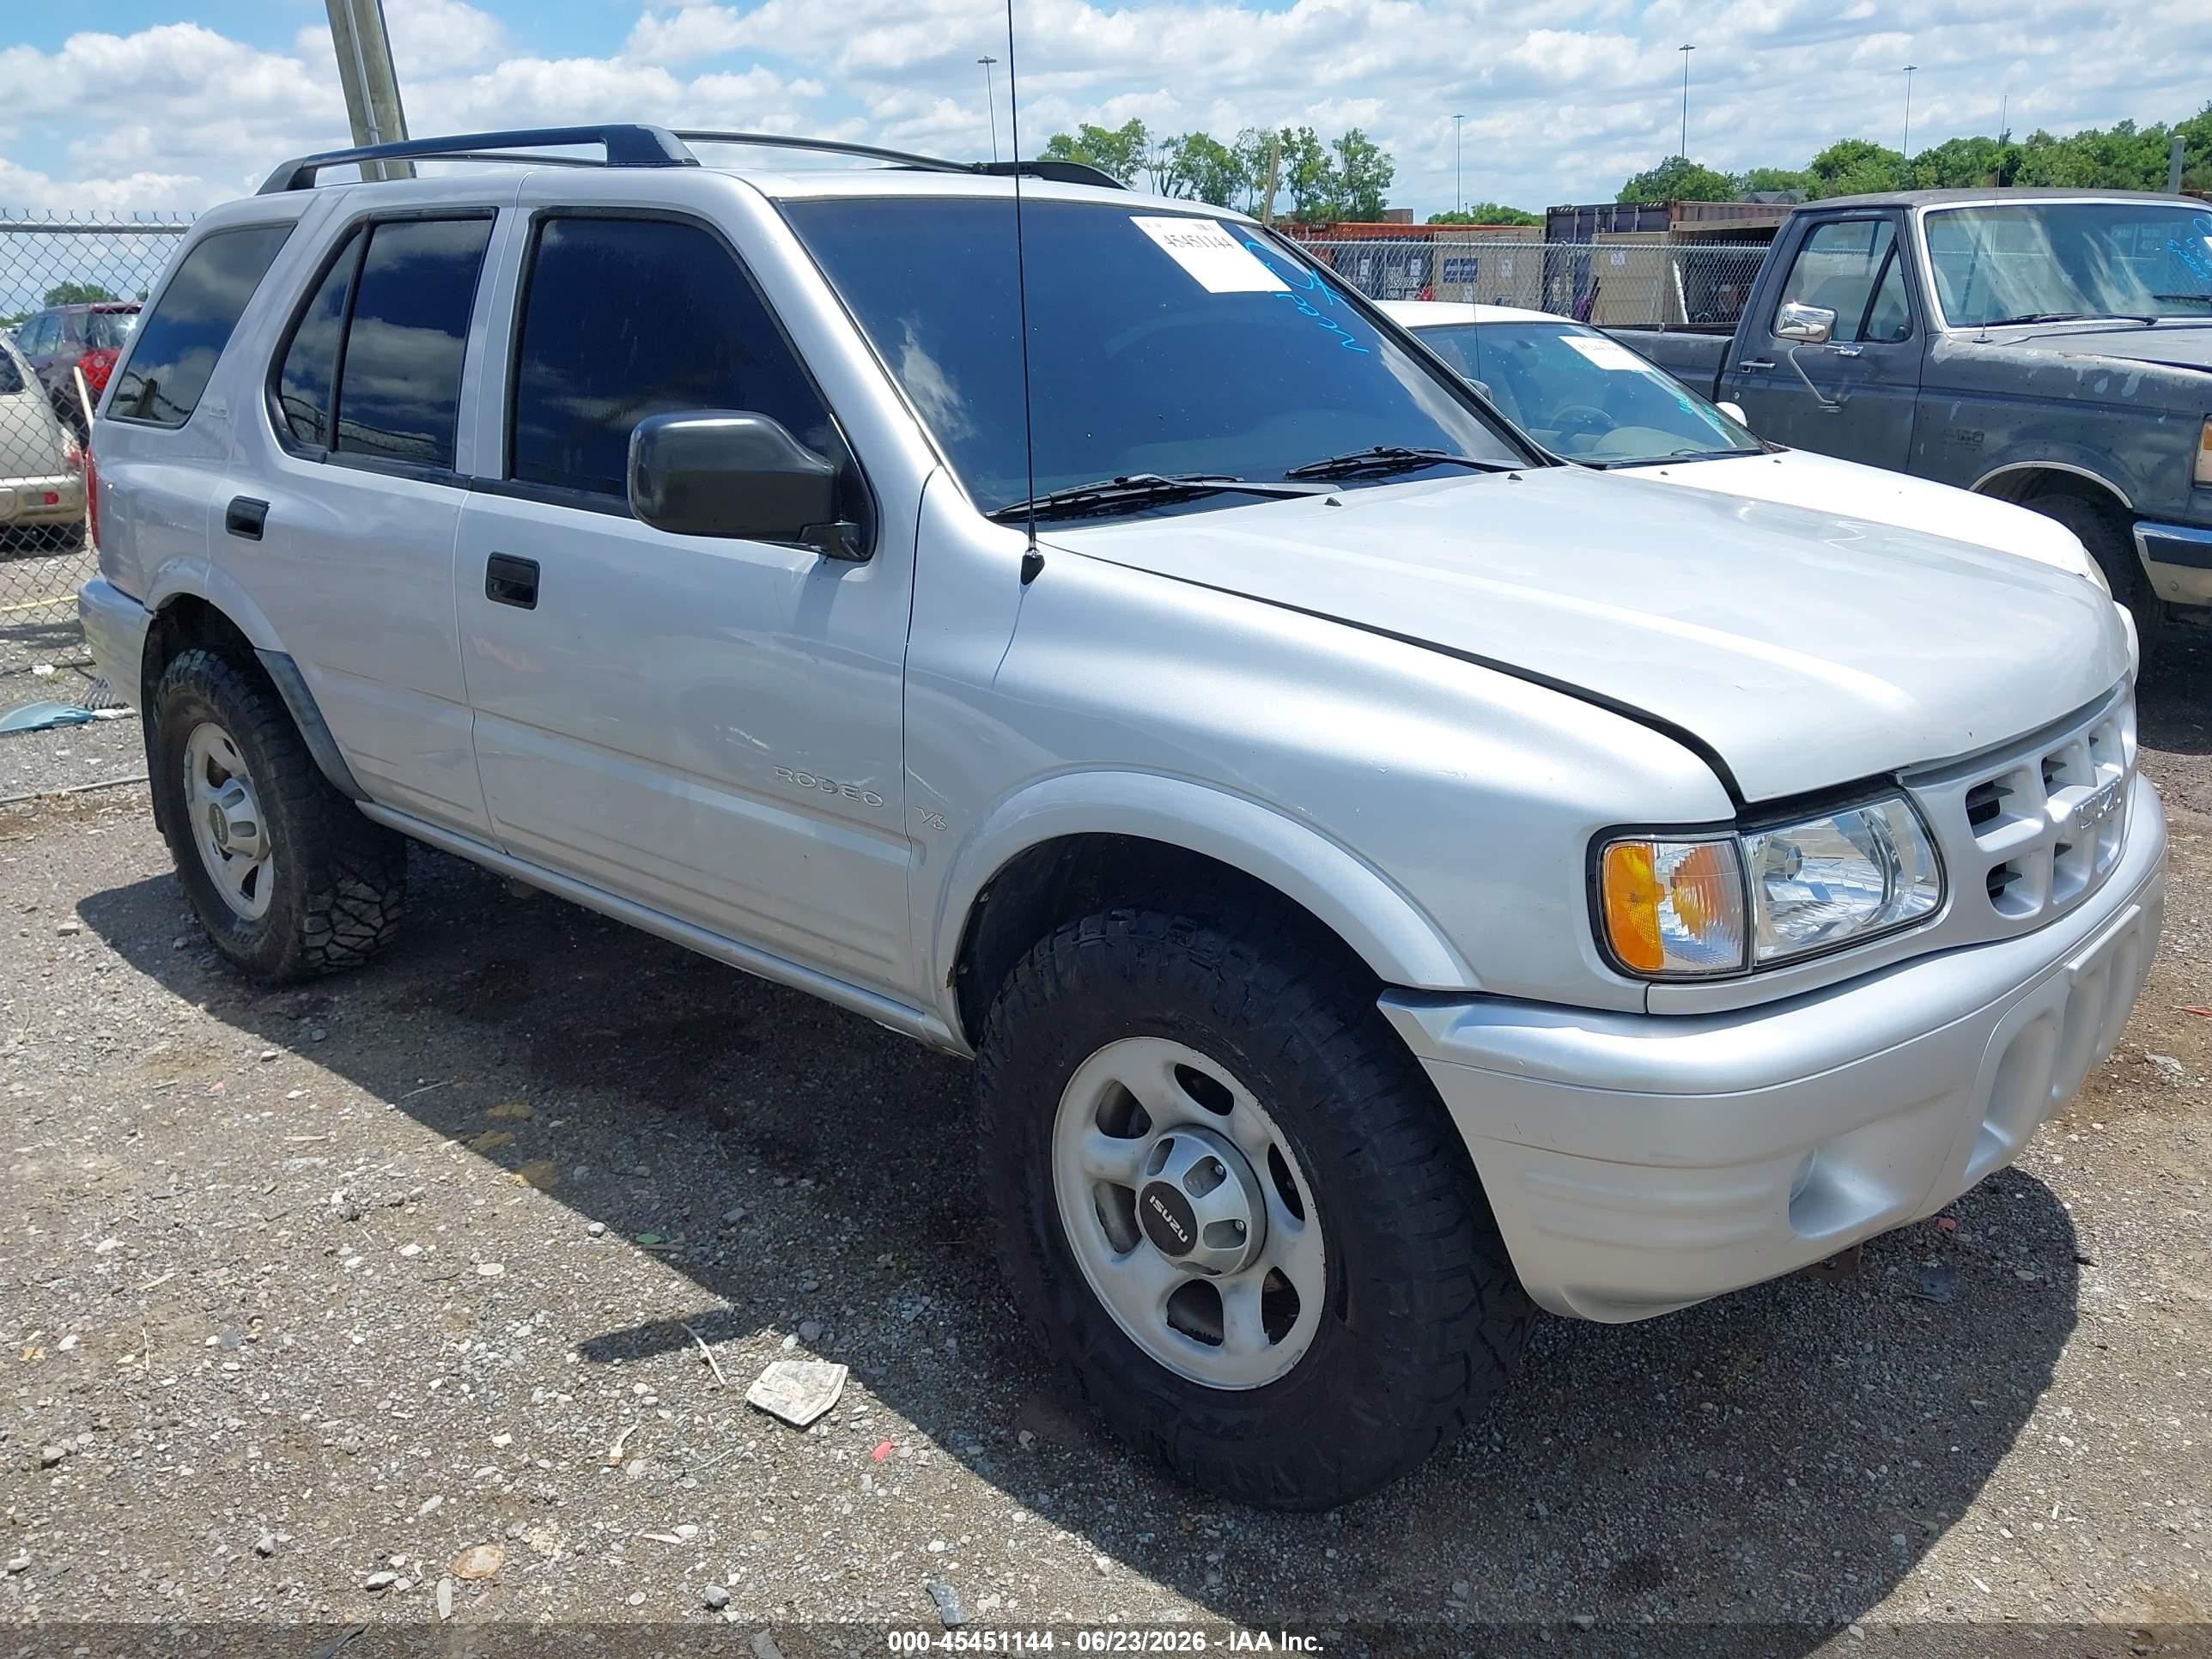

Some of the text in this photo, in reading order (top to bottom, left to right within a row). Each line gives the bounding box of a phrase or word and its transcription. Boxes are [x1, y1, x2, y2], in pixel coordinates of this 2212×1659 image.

[1163, 234, 1235, 249] 45451144
[773, 764, 884, 808] RODEO
[915, 805, 948, 831] V6
[1149, 1194, 1189, 1244] ISUZU
